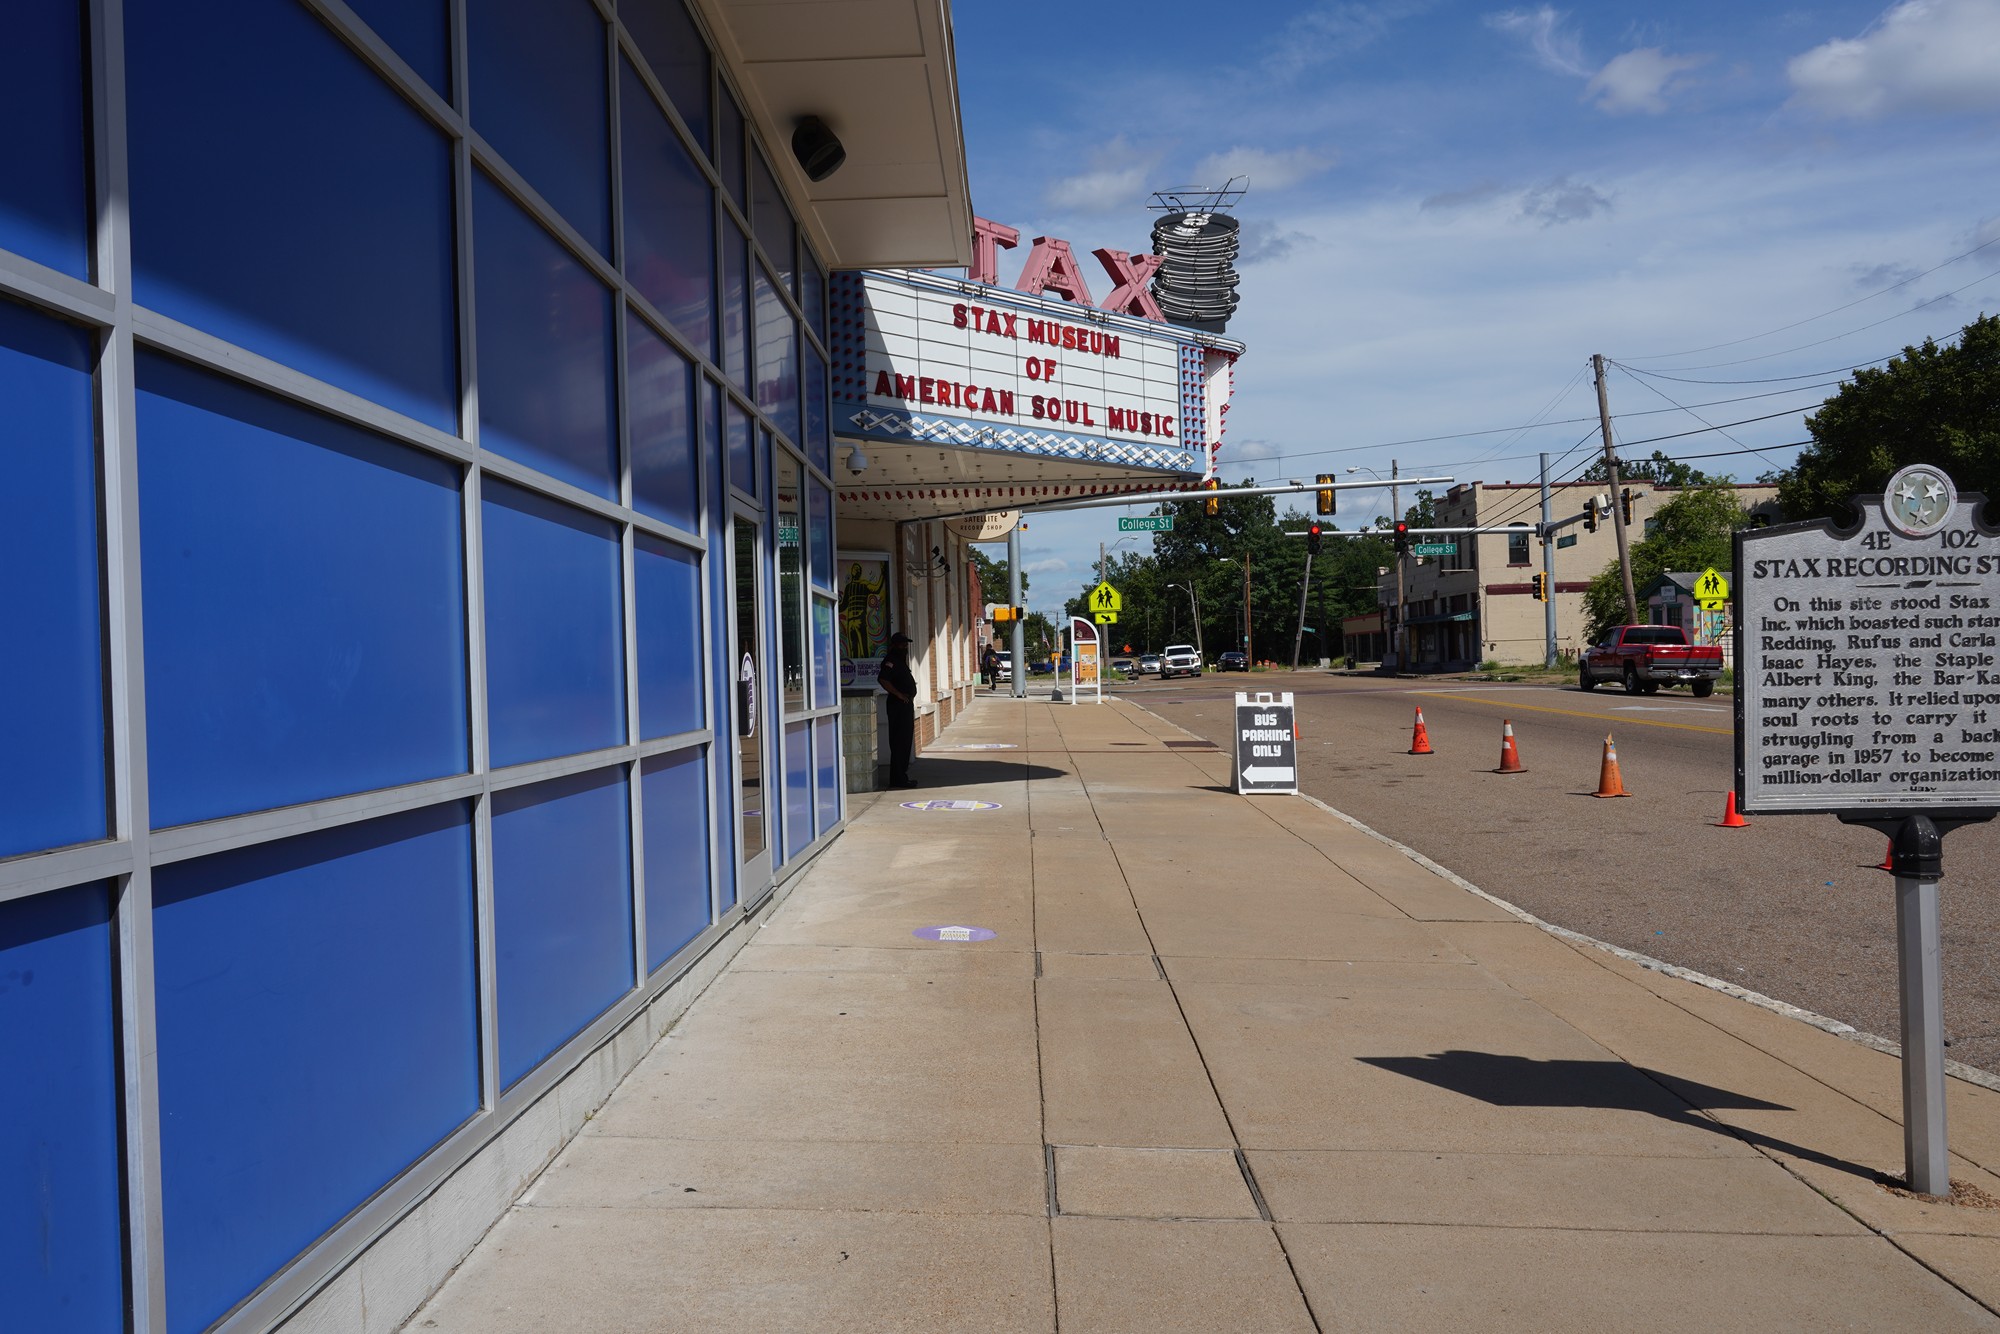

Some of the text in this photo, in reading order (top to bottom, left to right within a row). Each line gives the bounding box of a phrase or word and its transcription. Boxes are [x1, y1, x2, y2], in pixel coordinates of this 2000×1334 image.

[969, 215, 1168, 323] TAX
[953, 303, 1120, 359] STAX MUSEUM
[1026, 356, 1057, 383] OF
[874, 370, 1174, 438] AMERICAN SOUL MUSIC
[964, 515, 998, 523] SATELLITE
[1121, 518, 1170, 530] College St
[1860, 530, 1980, 550] 4E 102
[1418, 545, 1454, 555] College St
[1753, 559, 1821, 579] STAX
[1826, 556, 1971, 577] RECORDING
[1773, 594, 1990, 612] On this site stood Stax
[1795, 616, 1845, 631] which
[1849, 614, 1920, 630] boasted
[1924, 614, 1963, 629] such
[1847, 634, 1901, 649] Rufus
[1909, 633, 1942, 648] and
[1949, 633, 1996, 648] Carla
[1762, 655, 1804, 670] Isaac
[1893, 653, 1922, 668] the
[1935, 653, 1994, 669] Staple
[1762, 672, 1821, 686] Albert
[1893, 671, 1922, 685] the
[1762, 697, 1811, 710] many
[1817, 693, 1878, 707] others.
[1889, 691, 1903, 706] It
[1907, 691, 1960, 706] relied
[1254, 714, 1277, 726] BUS
[1762, 710, 1987, 727] soul roots to carry it
[1242, 729, 1291, 741] PARKING
[1762, 731, 1854, 749] struggling
[1872, 730, 1917, 744] from
[1933, 732, 1944, 743] a
[1252, 745, 1282, 757] ONLY
[1762, 748, 1995, 769] garage in 1957 to become
[1762, 768, 1882, 784] million-dollar
